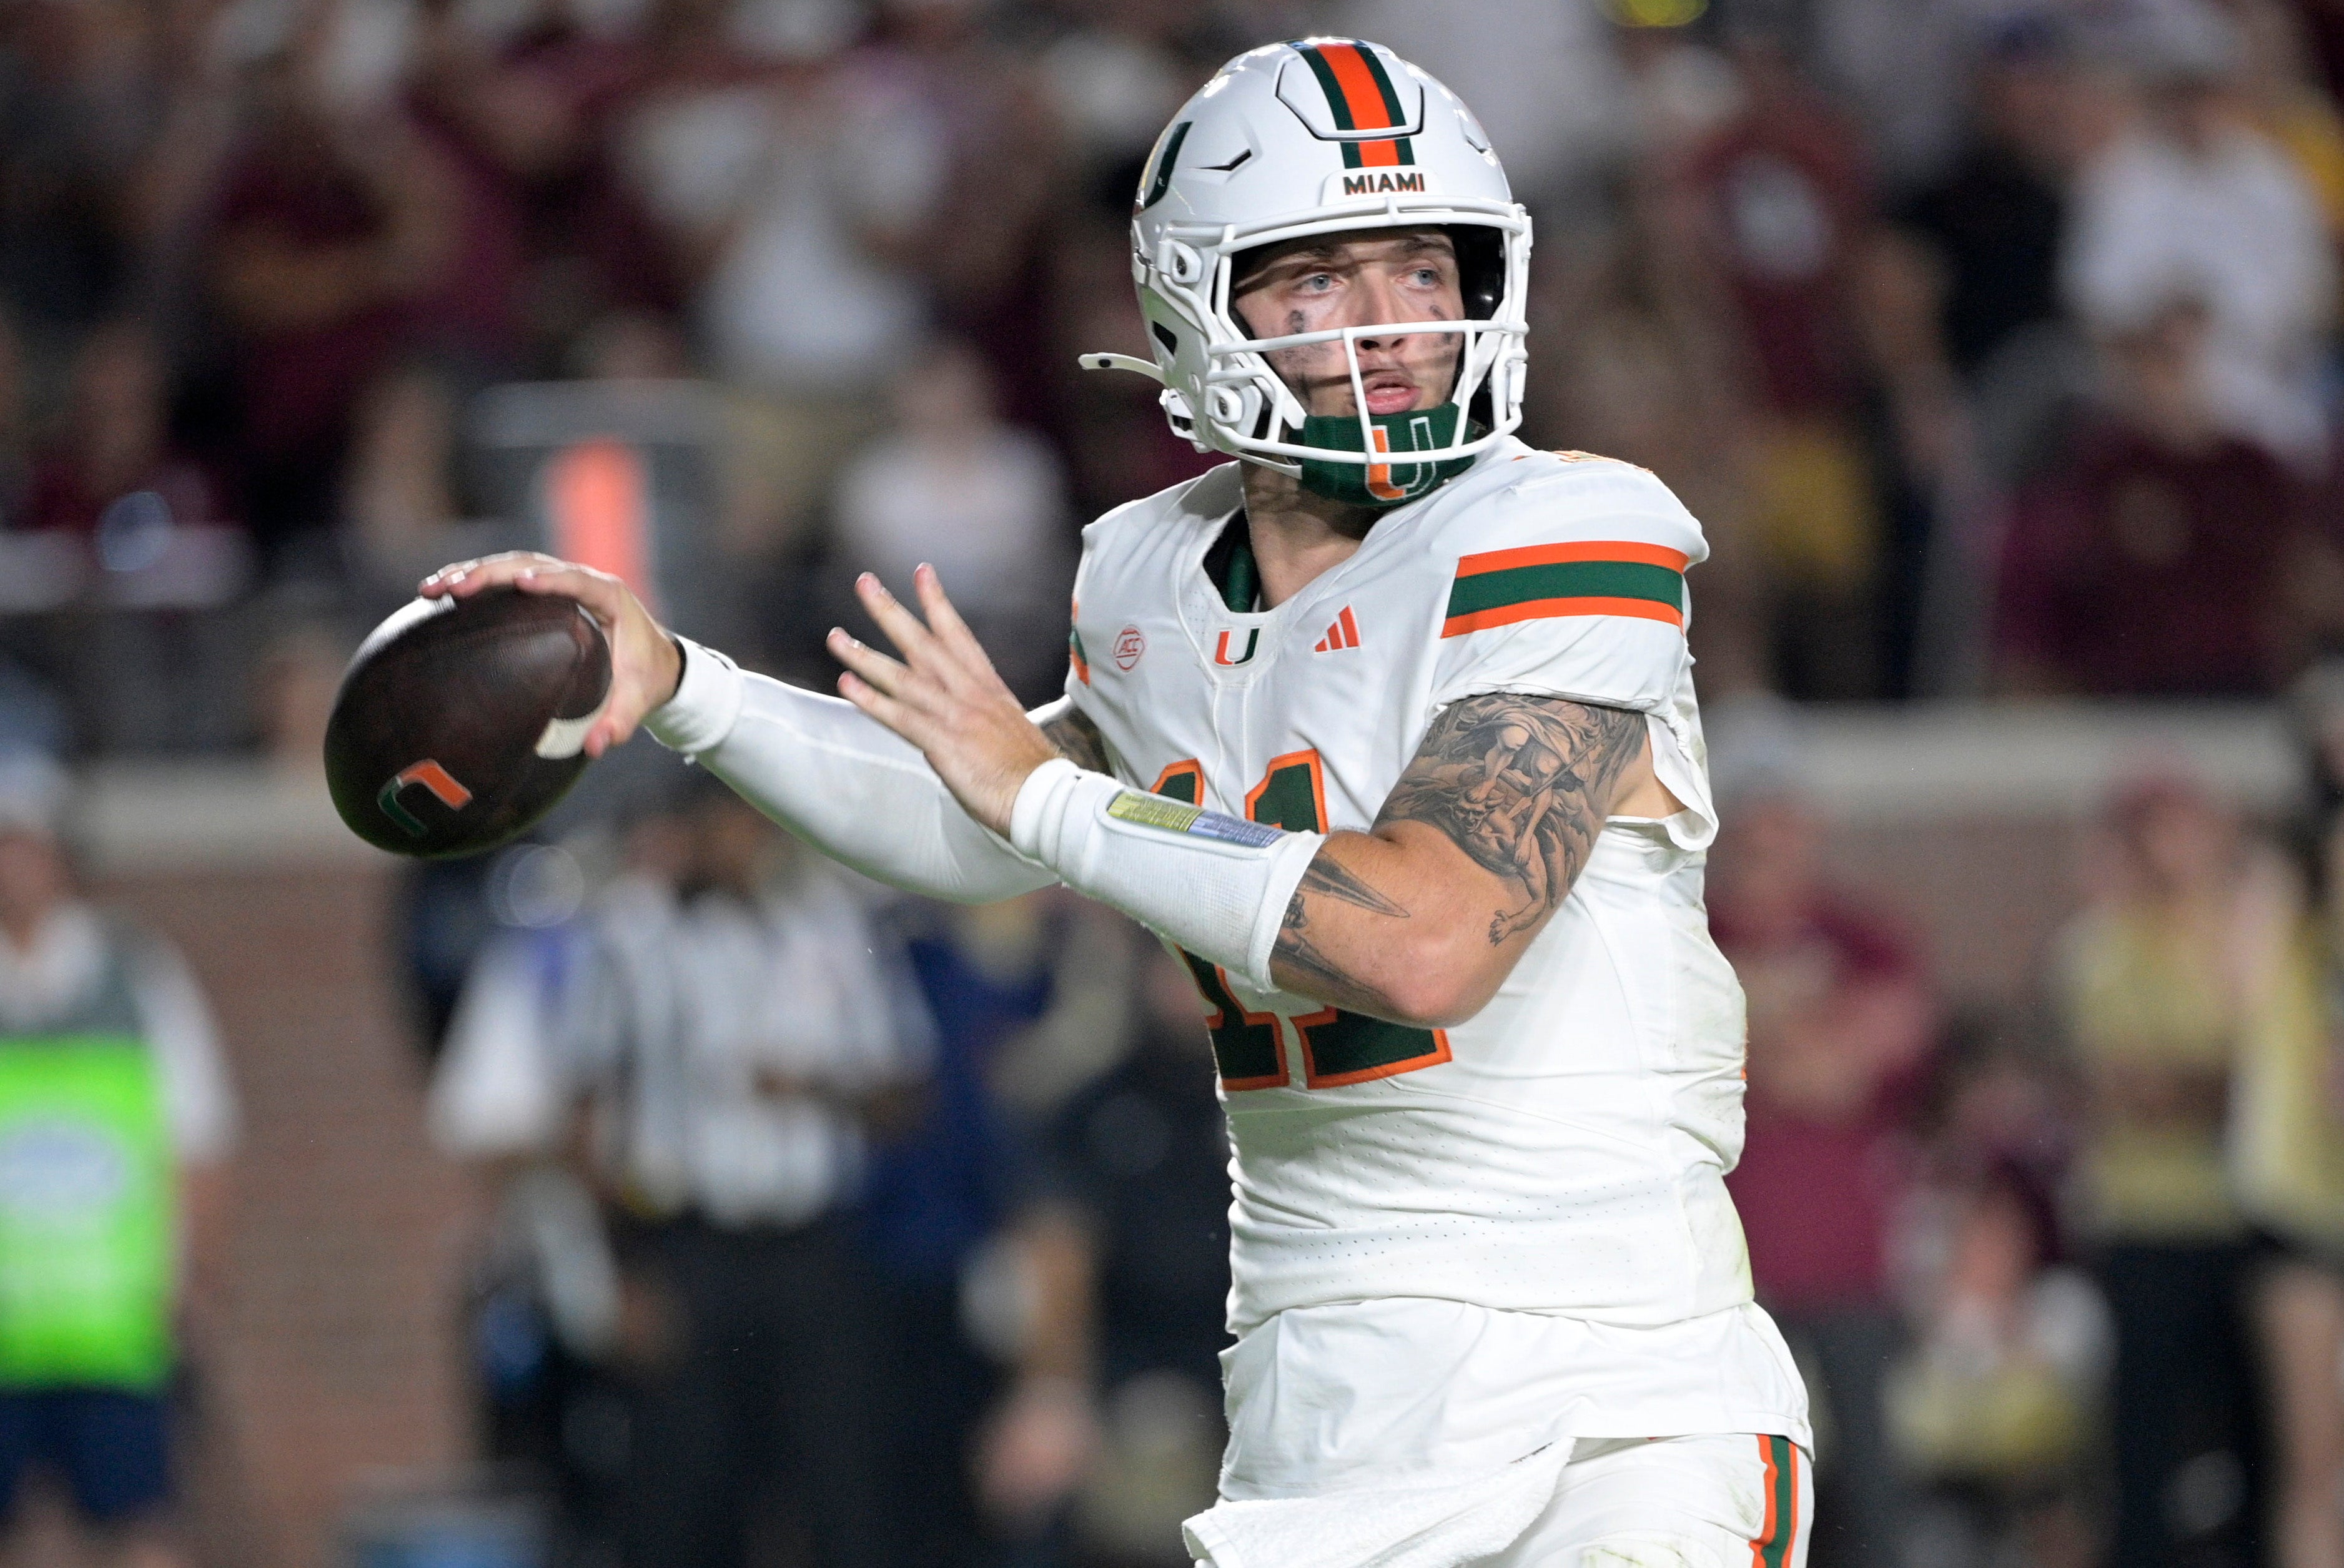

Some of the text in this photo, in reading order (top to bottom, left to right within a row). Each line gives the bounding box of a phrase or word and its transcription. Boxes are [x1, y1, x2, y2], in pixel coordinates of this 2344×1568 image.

[1343, 172, 1425, 195] MIAMI
[1365, 416, 1437, 500] U
[1118, 637, 1142, 653] ACC
[1214, 626, 1260, 666] U
[377, 757, 473, 837] U
